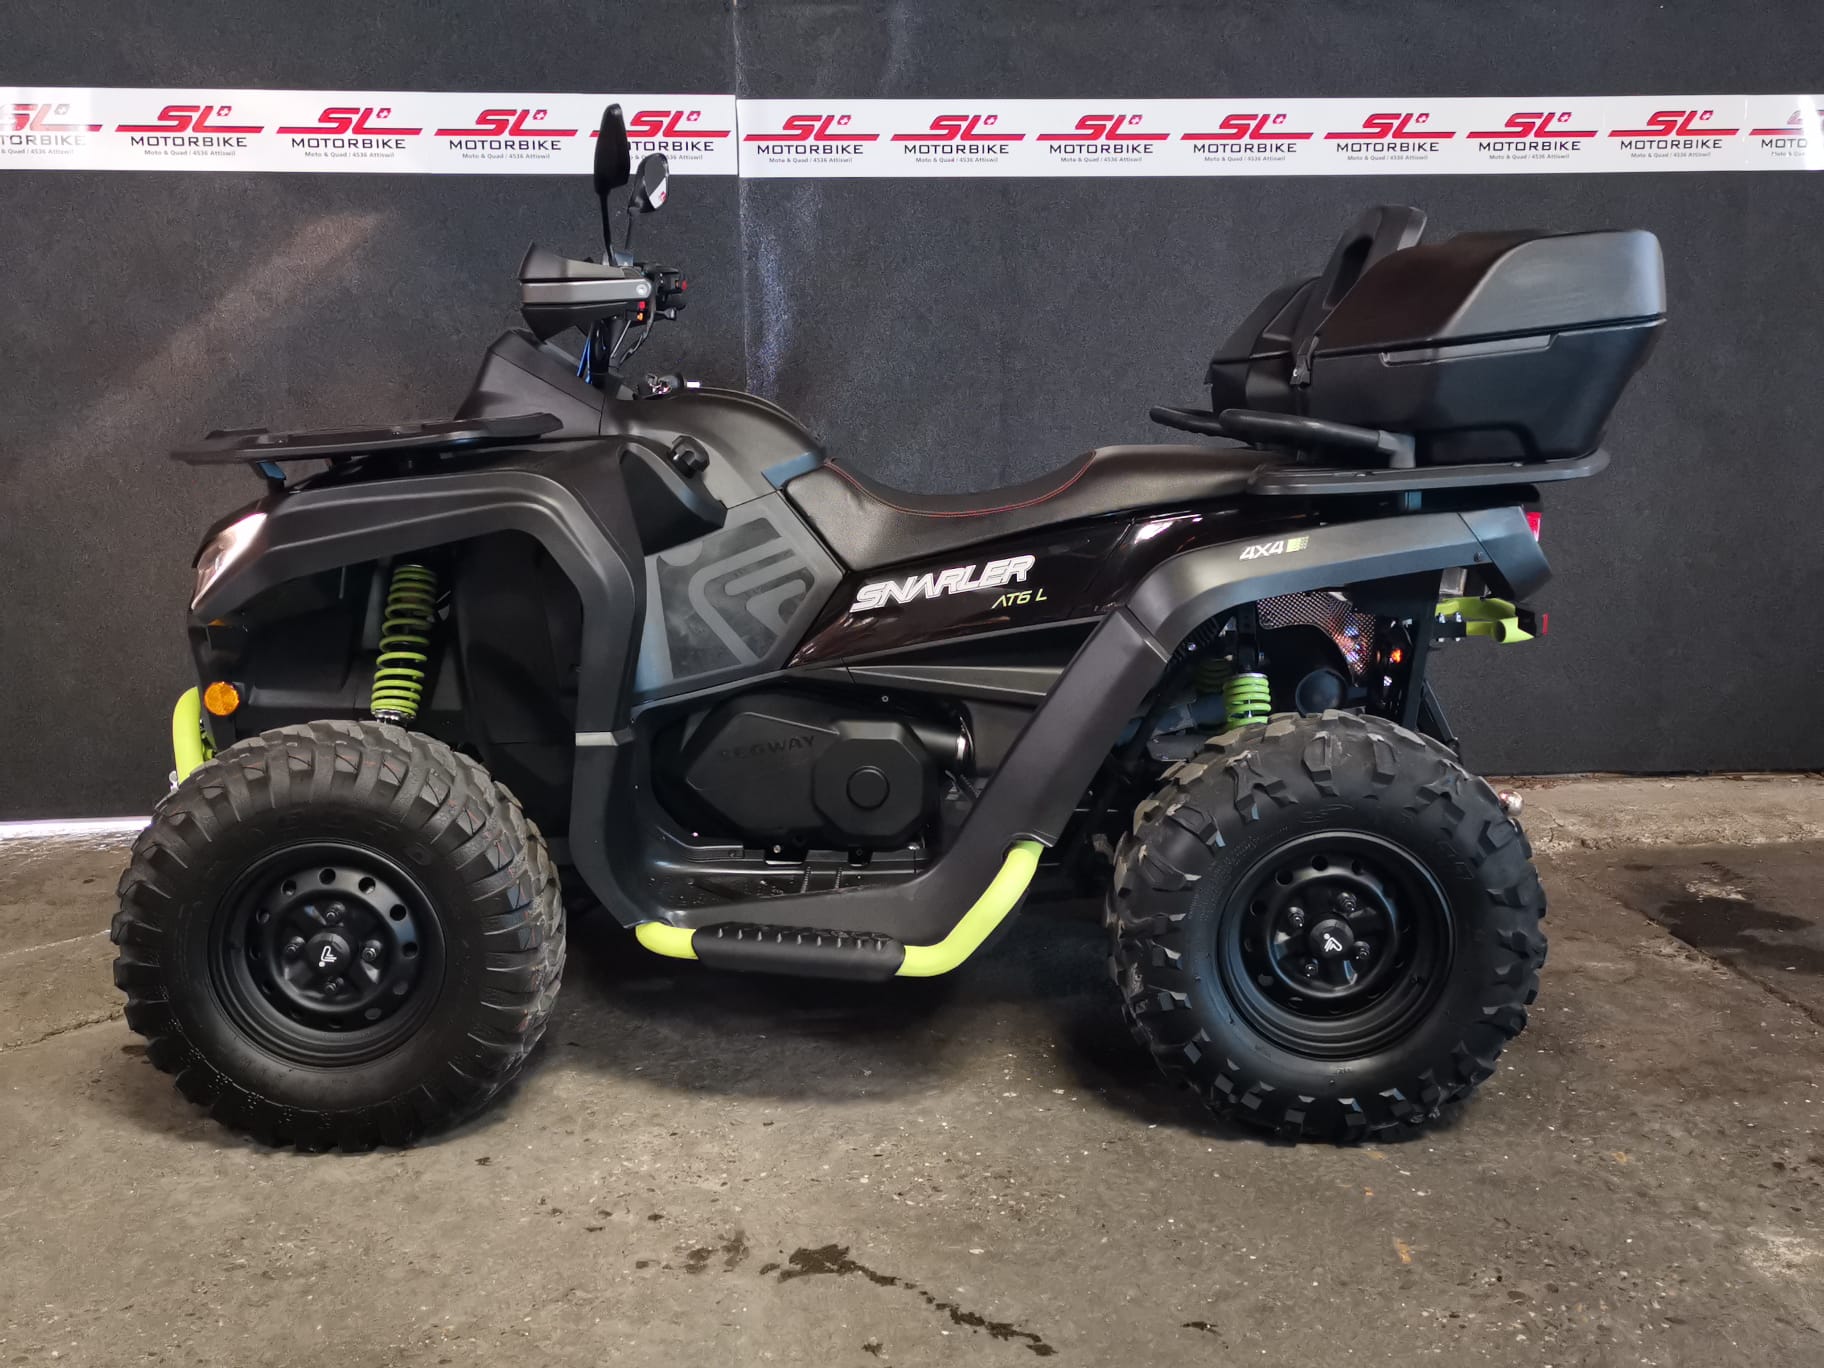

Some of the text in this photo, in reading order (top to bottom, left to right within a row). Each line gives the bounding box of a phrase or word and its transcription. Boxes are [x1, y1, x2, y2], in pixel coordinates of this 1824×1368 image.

[130, 136, 247, 147] MOTORBIKE
[291, 138, 406, 149] MOTORBIKE
[449, 139, 561, 151] MOTORBIKE
[628, 141, 714, 151] TORBIKE
[1336, 142, 1440, 152] MOTORBIKE
[1479, 141, 1581, 152] MOTORBIKE
[1620, 139, 1723, 150] MOTORBIKE
[757, 144, 864, 155] MOTORBIKE
[904, 144, 1009, 154] MOTORBIKE
[1049, 144, 1153, 154] MOTORBIKE
[1193, 143, 1297, 153] MOTORBIKE
[849, 554, 1036, 612] SNARLER
[991, 588, 1047, 609] AT6 L
